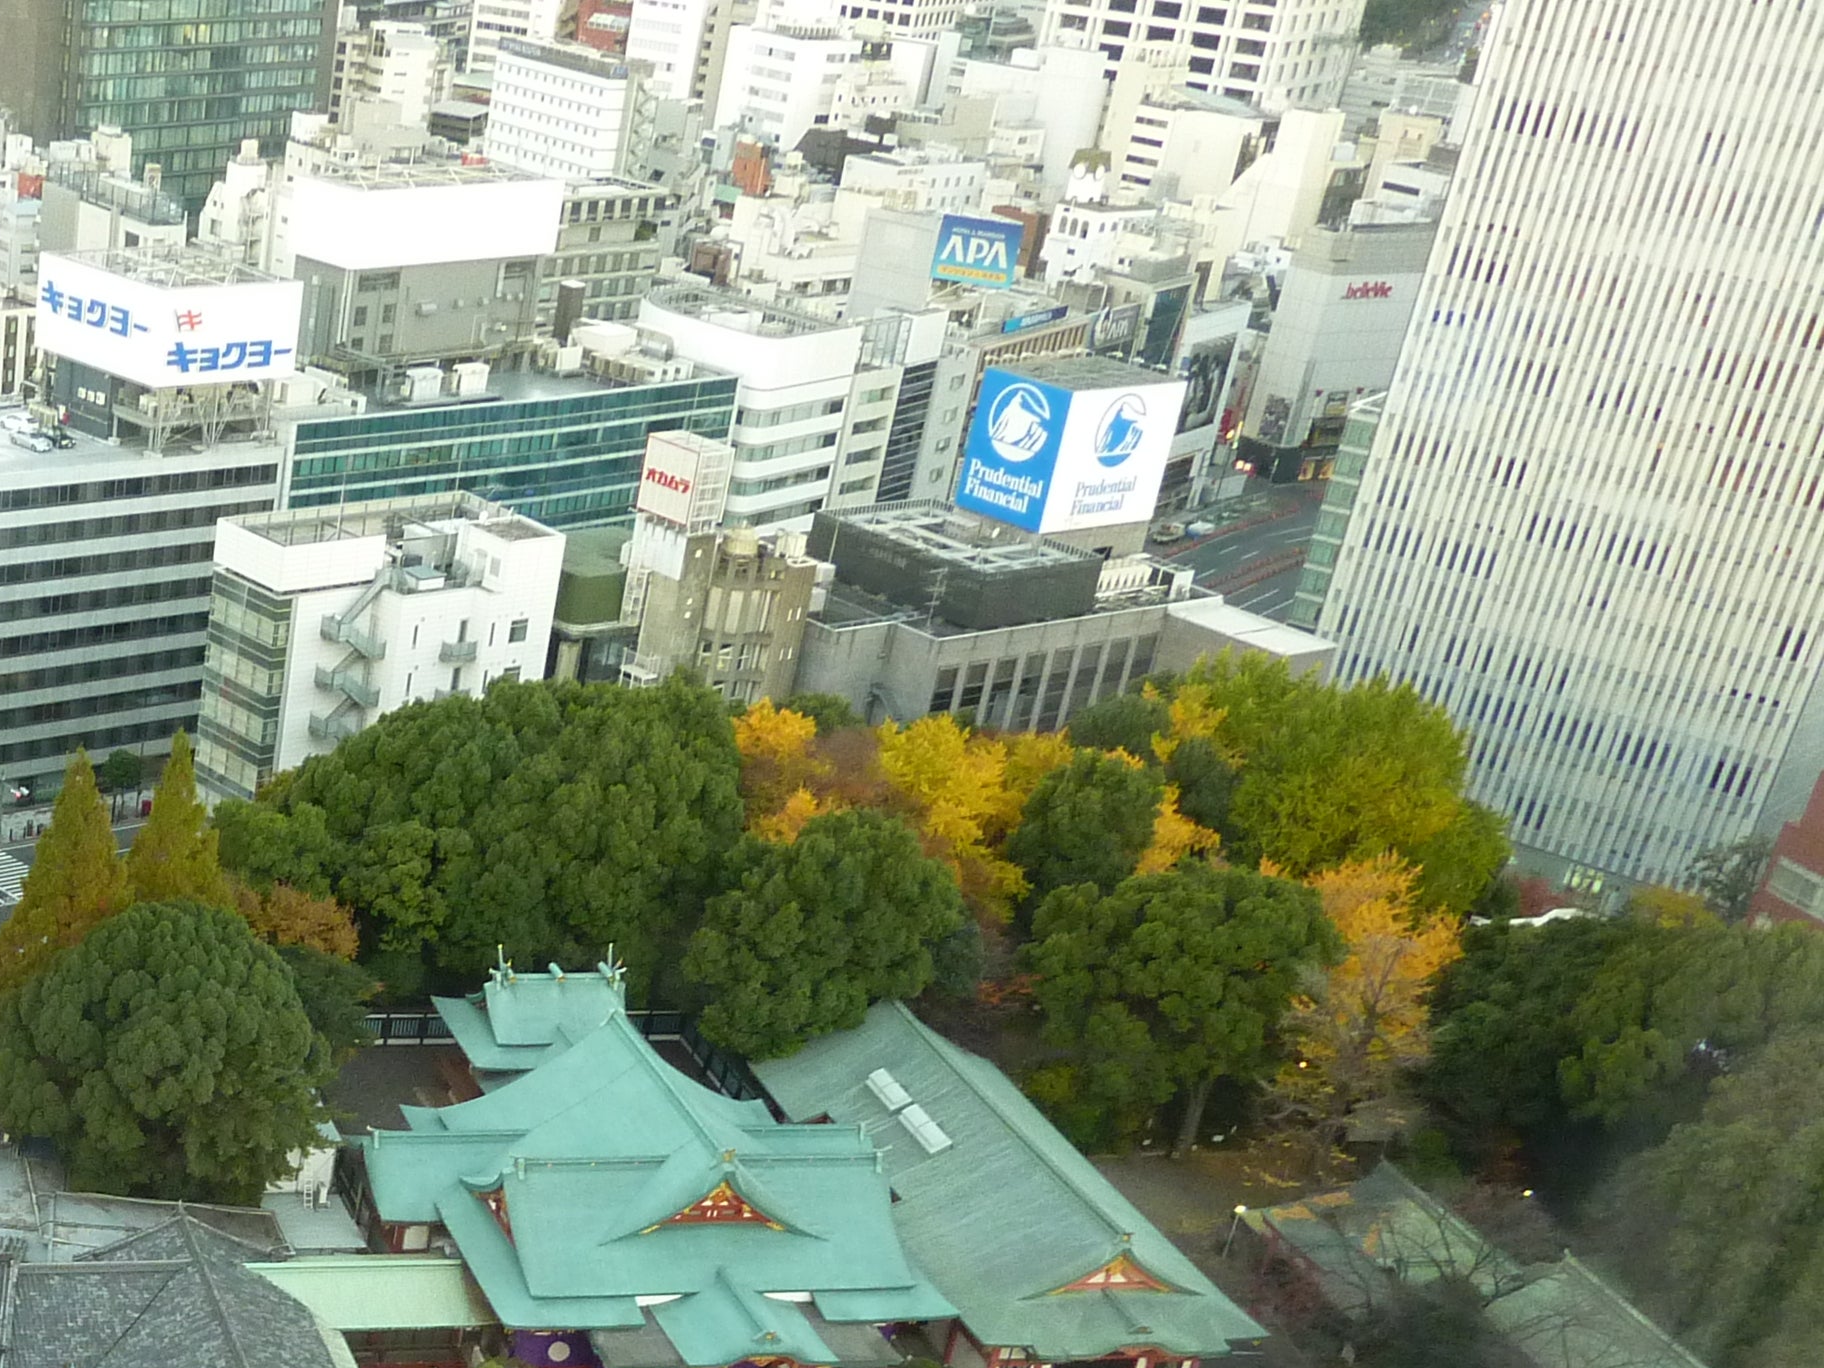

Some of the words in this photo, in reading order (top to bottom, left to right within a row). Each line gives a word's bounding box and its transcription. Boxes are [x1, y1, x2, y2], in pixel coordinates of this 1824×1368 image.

[939, 234, 1008, 270] APA
[41, 280, 151, 337] キョクヨー
[166, 340, 293, 373] キョクヨー
[964, 477, 1029, 514] Financial
[969, 458, 1044, 499] Prudential
[1075, 475, 1137, 498] Prudential
[1070, 495, 1125, 516] Financial
